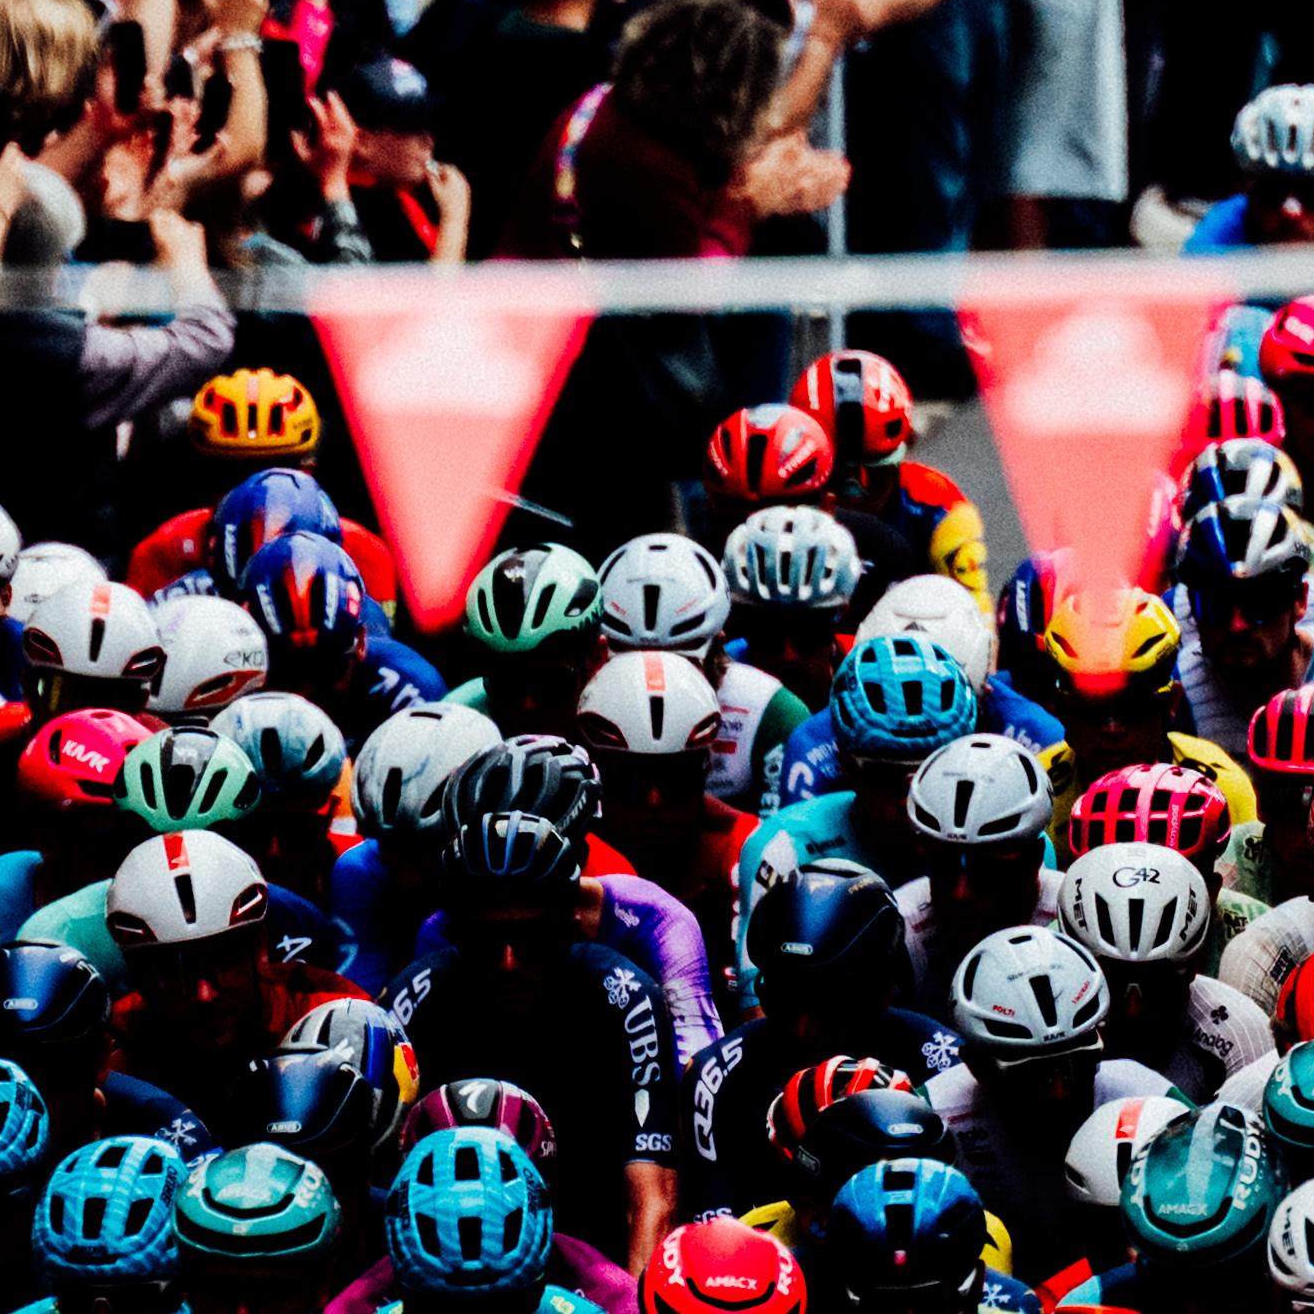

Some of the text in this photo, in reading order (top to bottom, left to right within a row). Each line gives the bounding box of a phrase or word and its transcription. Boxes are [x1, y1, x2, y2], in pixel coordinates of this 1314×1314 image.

[61, 737, 111, 773] KASK
[1112, 866, 1161, 889] G42
[1075, 877, 1089, 932] MET
[390, 967, 432, 1026] 6.5
[991, 1003, 1016, 1017] POLTI
[623, 994, 661, 1086] UBS
[635, 1133, 673, 1152] SGS
[1233, 1116, 1265, 1211] RUDY
[1157, 1202, 1208, 1217] AMACX
[704, 1275, 758, 1291] AMACX
